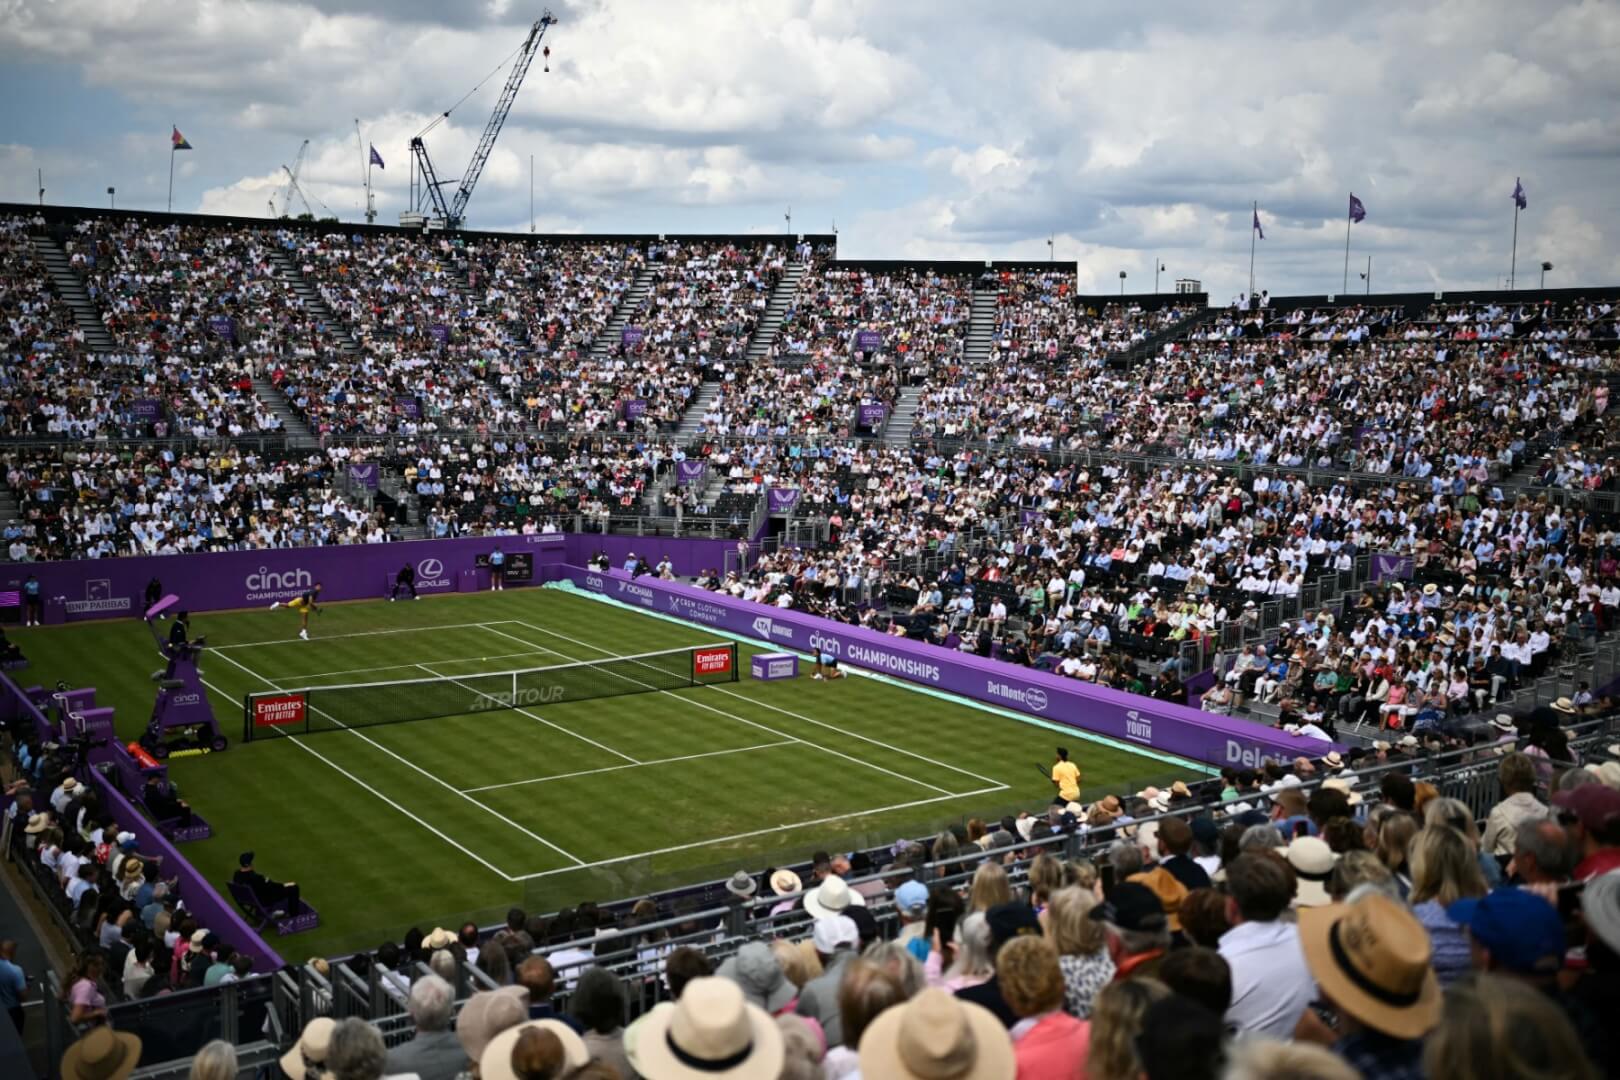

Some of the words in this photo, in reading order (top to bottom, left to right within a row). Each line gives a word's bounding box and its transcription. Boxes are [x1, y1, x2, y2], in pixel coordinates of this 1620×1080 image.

[864, 408, 884, 416] cinch
[246, 566, 312, 591] cinch
[69, 601, 89, 611] BNP
[90, 599, 129, 609] PARIBAS
[680, 598, 696, 608] CREW
[697, 602, 727, 617] CLOTHING
[688, 608, 717, 621] COMPANY
[756, 620, 769, 633] LTA
[696, 652, 729, 664] Emirates
[809, 630, 841, 655] cinch
[848, 644, 940, 681] CHAMPIONSHIPS
[174, 693, 200, 703] cinch
[469, 690, 513, 711] ATP
[516, 685, 565, 705] TOUR
[987, 680, 1000, 695] Del
[1000, 685, 1026, 703] Monte
[257, 700, 302, 714] Emirates
[1126, 719, 1152, 739] YOUTH
